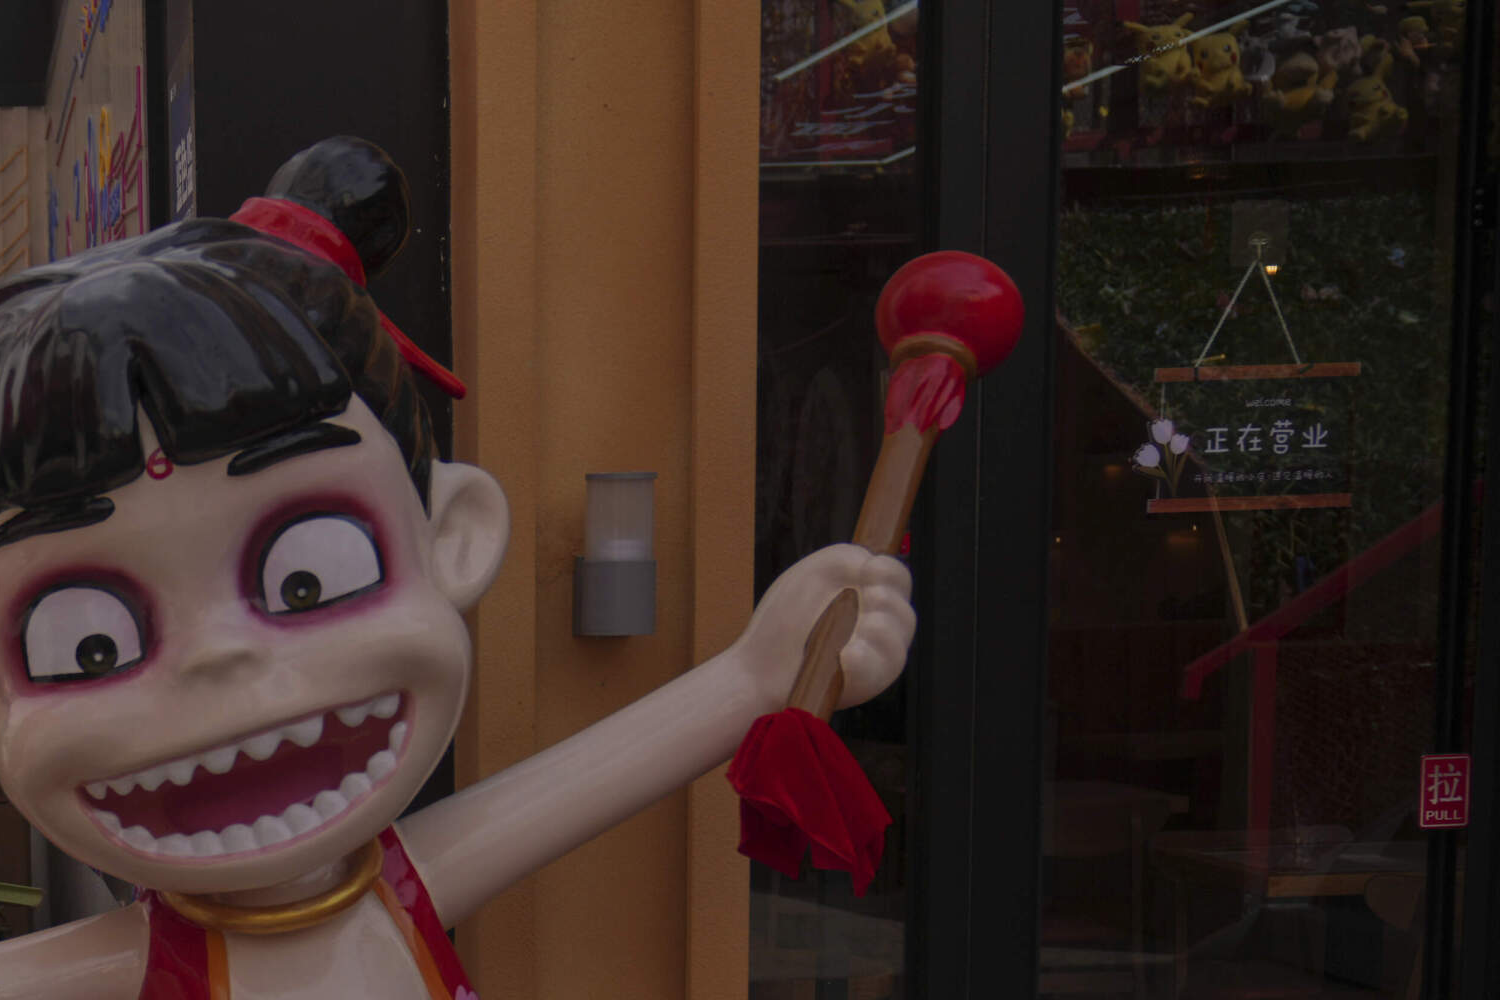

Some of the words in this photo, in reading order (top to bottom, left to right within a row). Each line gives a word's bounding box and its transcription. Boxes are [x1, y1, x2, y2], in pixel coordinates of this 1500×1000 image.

[1244, 397, 1293, 408] welcome
[1204, 419, 1329, 455] 正在营业
[1427, 763, 1463, 805] 拉
[1426, 809, 1463, 821] PULL
